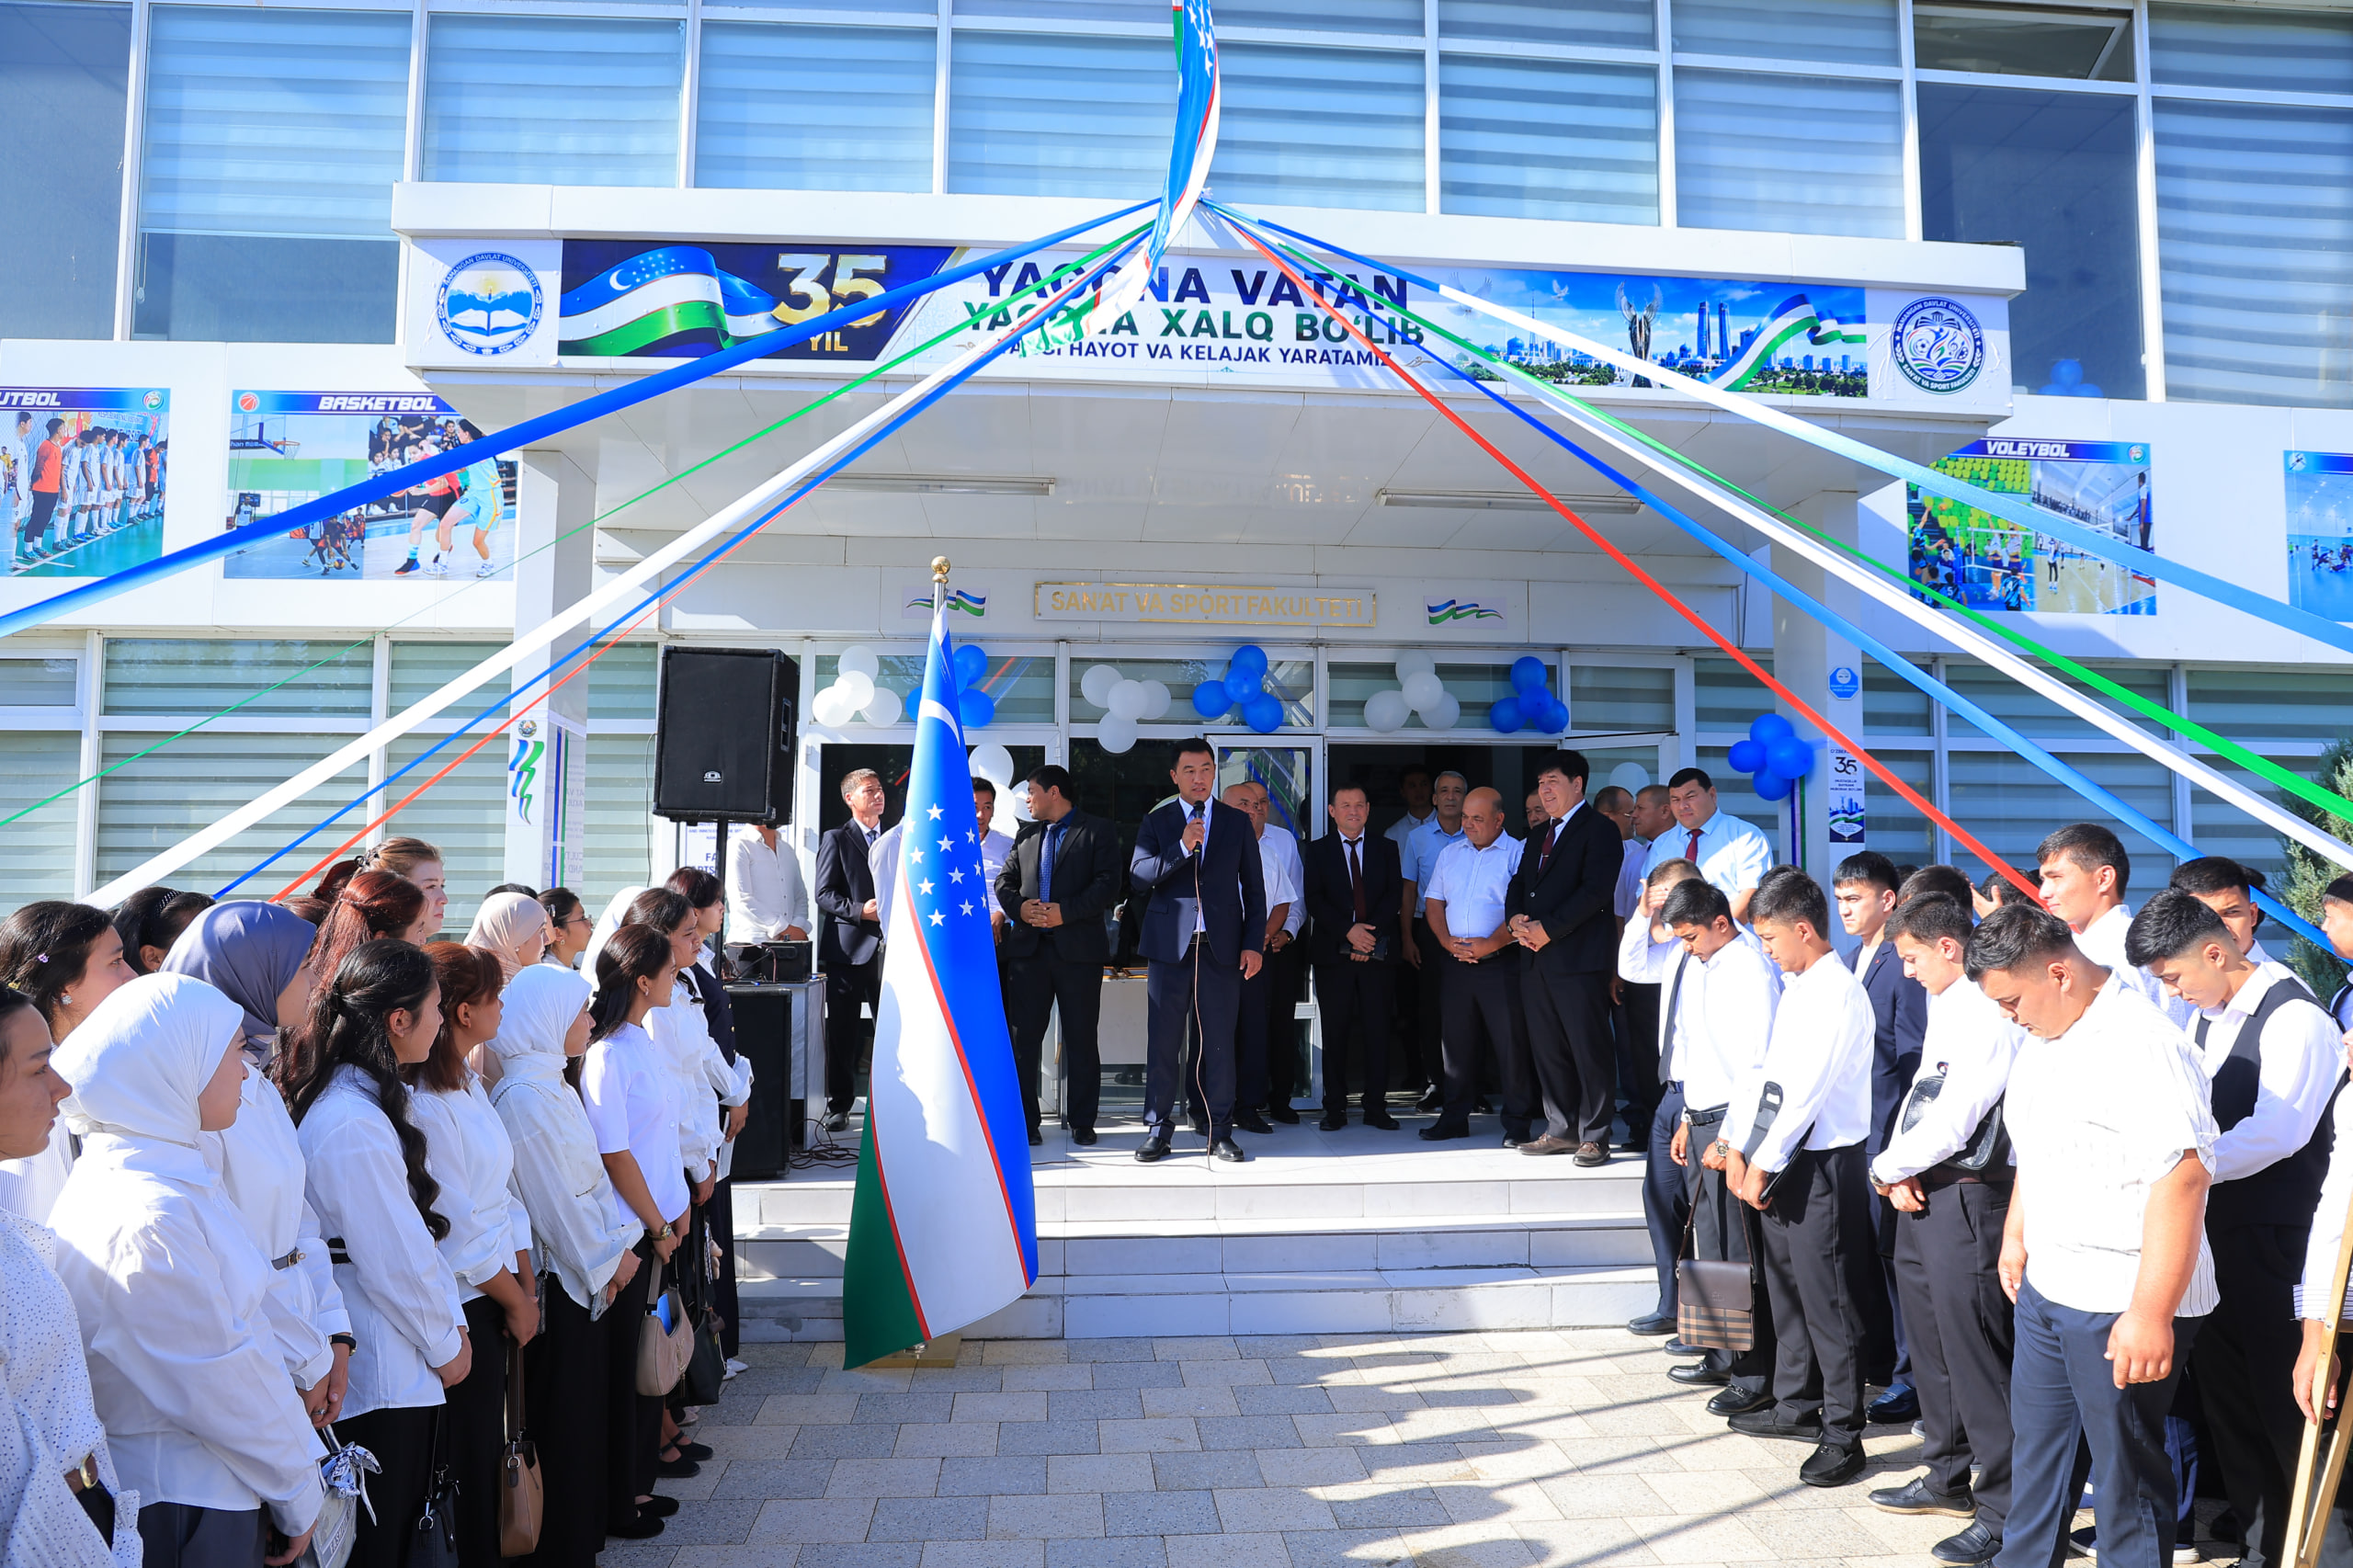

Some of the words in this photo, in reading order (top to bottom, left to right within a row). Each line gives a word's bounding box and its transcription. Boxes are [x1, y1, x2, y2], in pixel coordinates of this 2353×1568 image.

[475, 253, 501, 261] DAVLAT
[502, 254, 539, 287] UNIVERSITETI
[771, 253, 887, 328] 35
[1231, 269, 1407, 312] VATAN
[1160, 308, 1274, 343] XALQ
[1896, 303, 1924, 332] NAMANGAN
[1923, 300, 1948, 309] DAVLAT
[1949, 303, 1981, 339] UNIVERSITETI
[809, 331, 848, 352] YIL
[1070, 342, 1139, 358] HAYOT
[1146, 344, 1173, 359] VA
[1180, 345, 1271, 362] KELAJAK
[1921, 380, 1930, 389] VA
[1930, 381, 1950, 391] SPORT
[0, 392, 61, 406] UTBOL
[318, 396, 437, 411] BASKETBOL
[1986, 441, 2070, 457] VOLEYBOL
[1135, 593, 1165, 613] VA
[1170, 594, 1244, 615] SPORT
[1247, 597, 1362, 618] FAKULTETI
[1835, 756, 1858, 775] 35
[706, 853, 717, 861] FA
